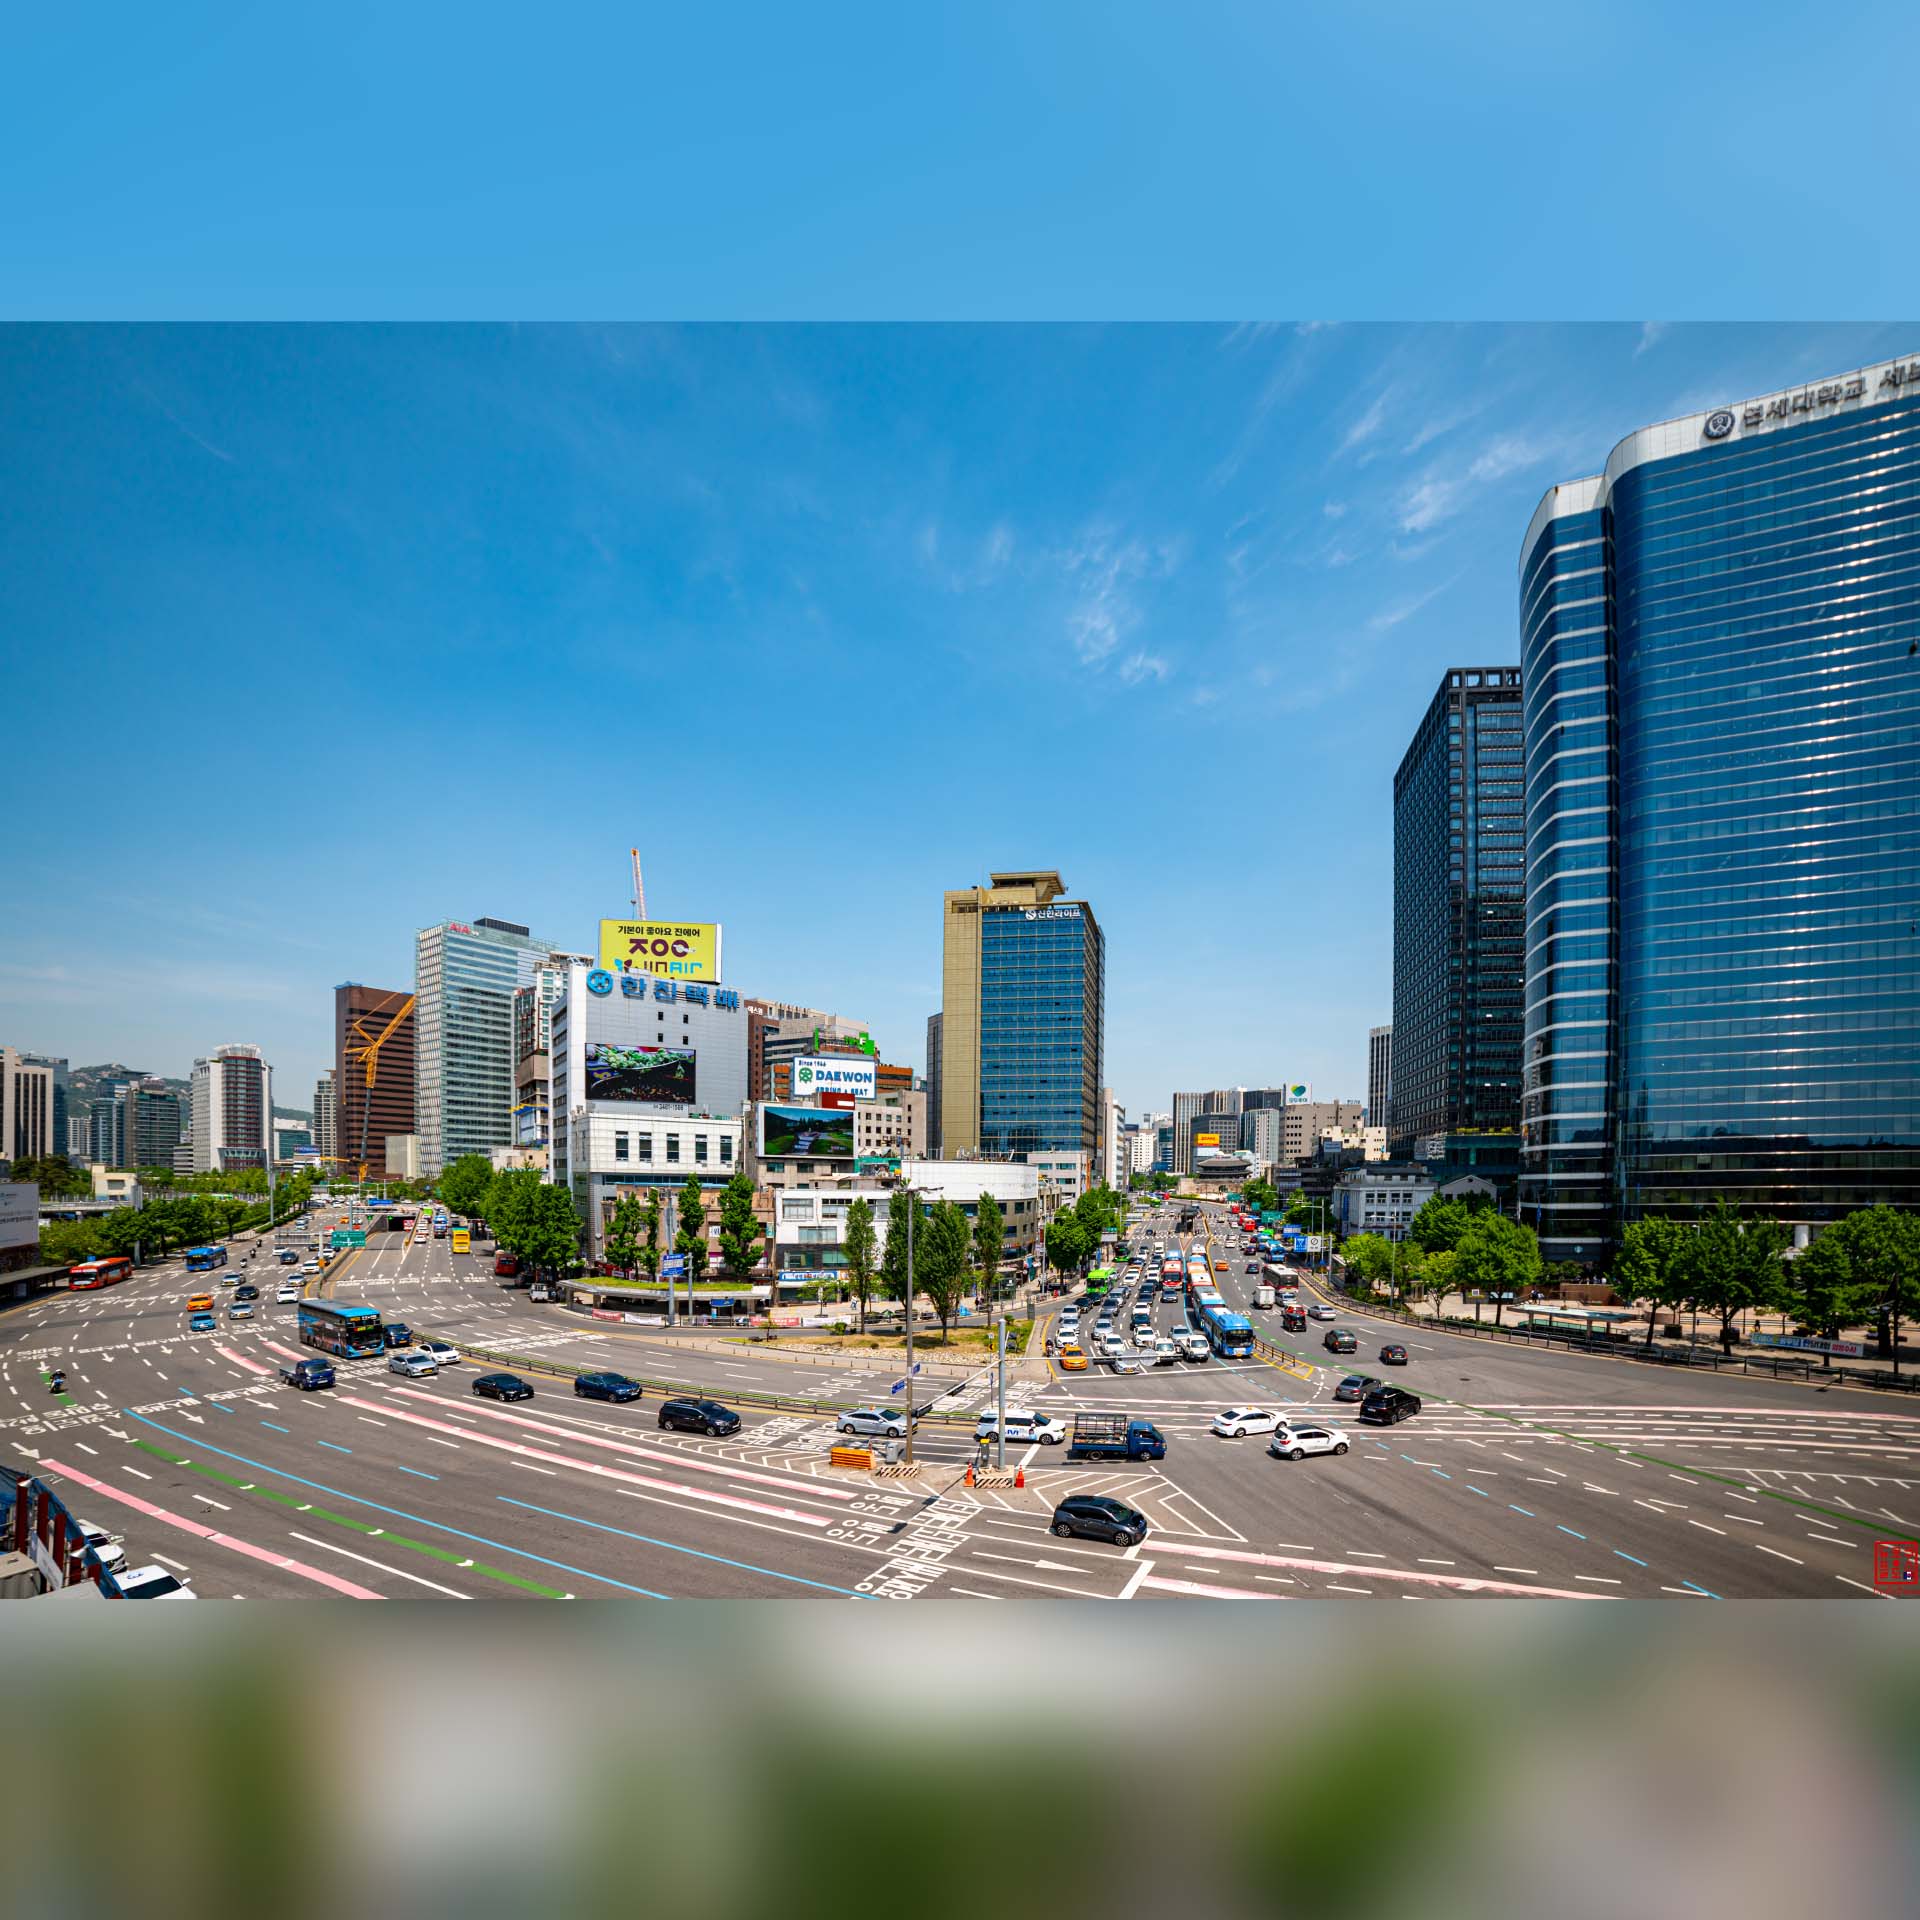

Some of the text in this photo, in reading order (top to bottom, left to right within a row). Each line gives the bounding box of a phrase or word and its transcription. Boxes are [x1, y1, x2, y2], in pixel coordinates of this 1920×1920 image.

[1743, 378, 1868, 428] 연세대학교
[1037, 908, 1081, 919] 신한라이프
[618, 926, 700, 937] 기본이 좋아요 진에어
[621, 976, 740, 1009] 한진택배
[815, 1070, 873, 1083] DAEWON
